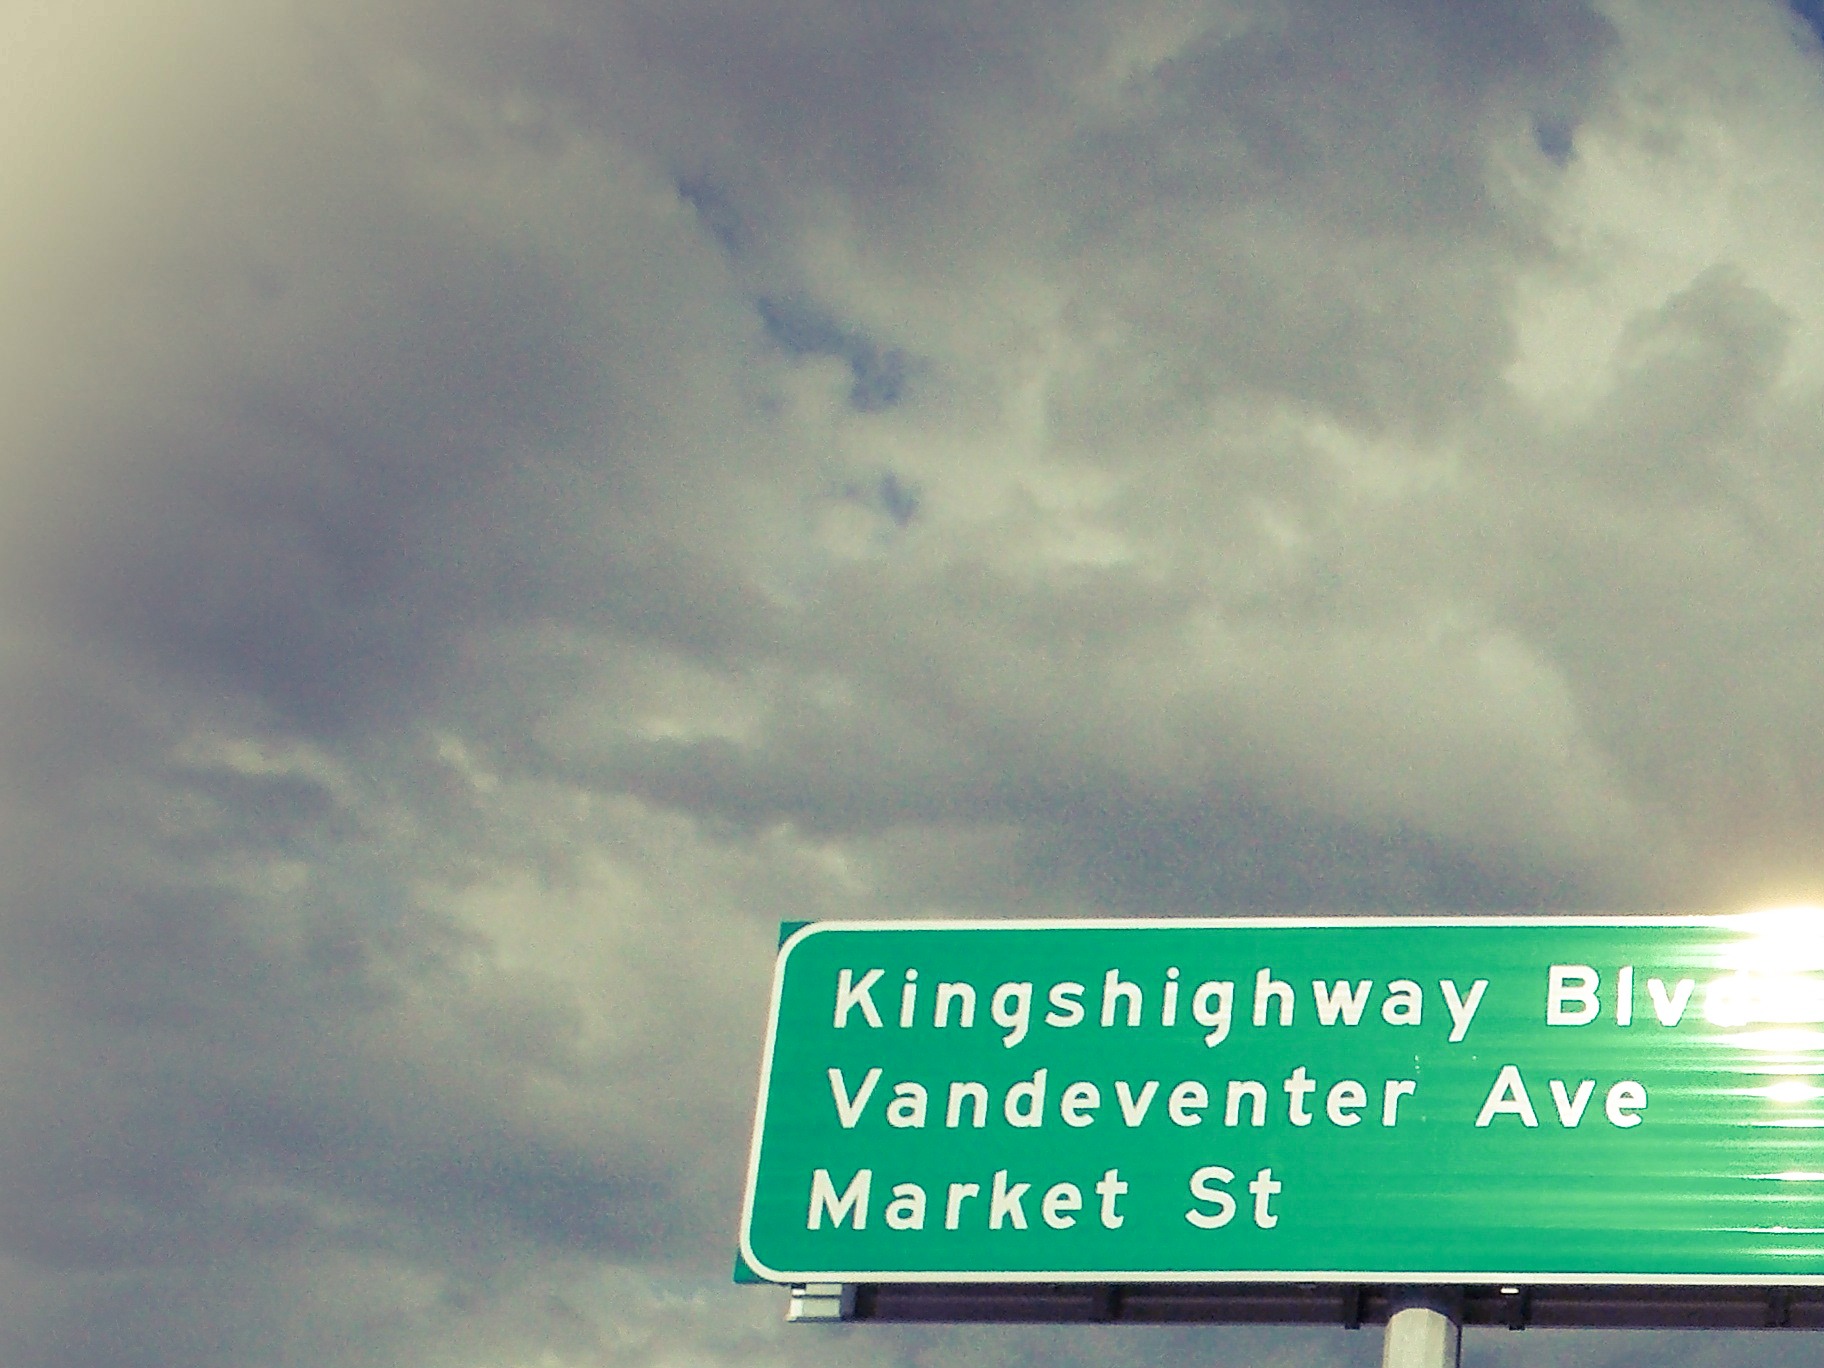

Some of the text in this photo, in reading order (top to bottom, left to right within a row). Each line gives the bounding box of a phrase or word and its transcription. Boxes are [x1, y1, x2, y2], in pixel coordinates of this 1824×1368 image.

[832, 968, 1489, 1048] Kingshighway
[827, 1066, 1416, 1128] Vandeventer
[1475, 1065, 1648, 1128] Ave
[806, 1168, 1128, 1230] Market
[1184, 1166, 1281, 1230] St
